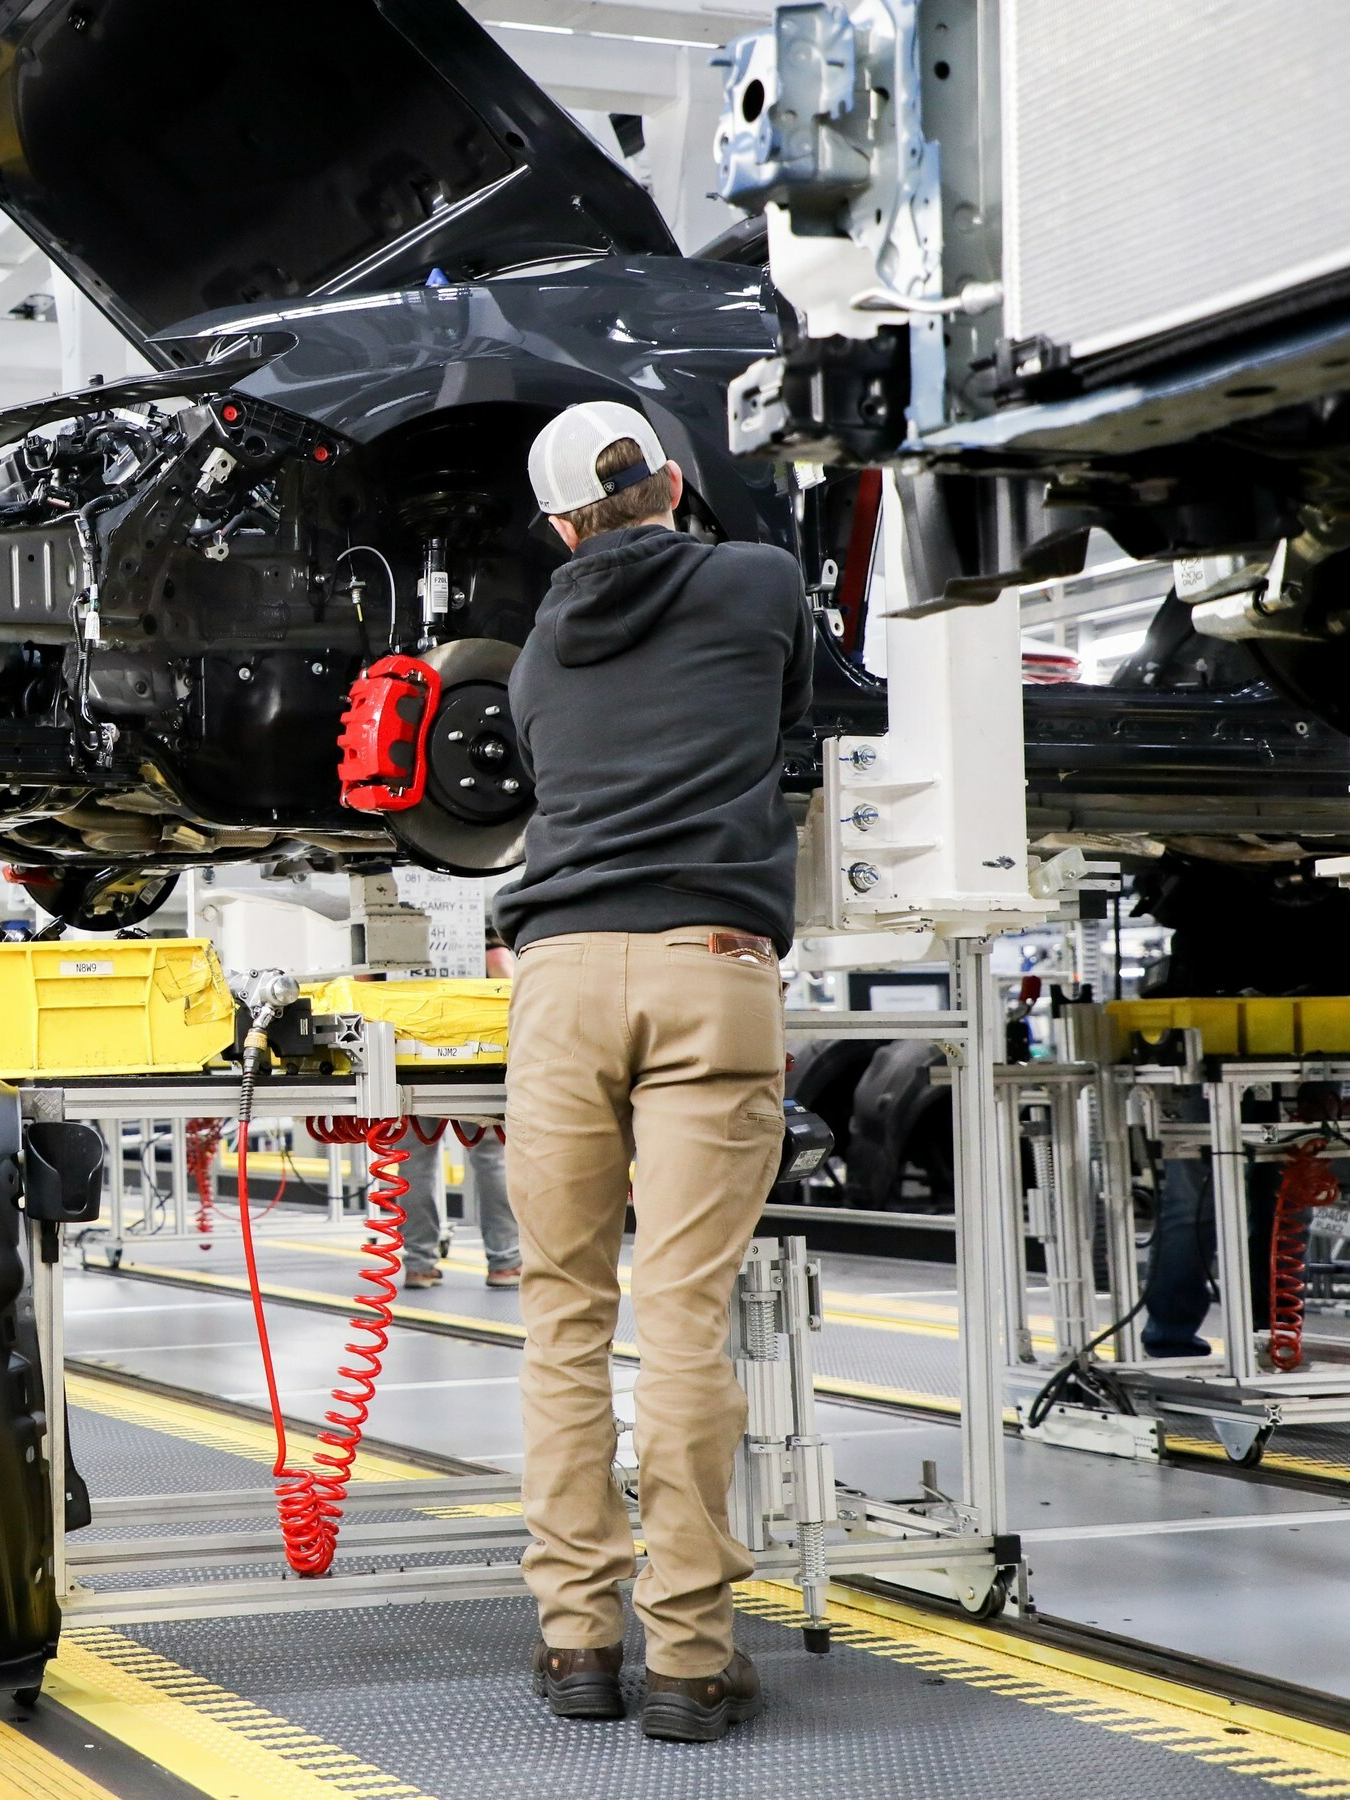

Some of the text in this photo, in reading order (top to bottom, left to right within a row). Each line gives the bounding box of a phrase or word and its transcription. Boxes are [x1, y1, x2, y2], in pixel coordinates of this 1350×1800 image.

[420, 901, 455, 911] CAMRY
[431, 927, 446, 938] 4H
[76, 963, 97, 972] N8W9
[437, 1047, 458, 1057] NJM2
